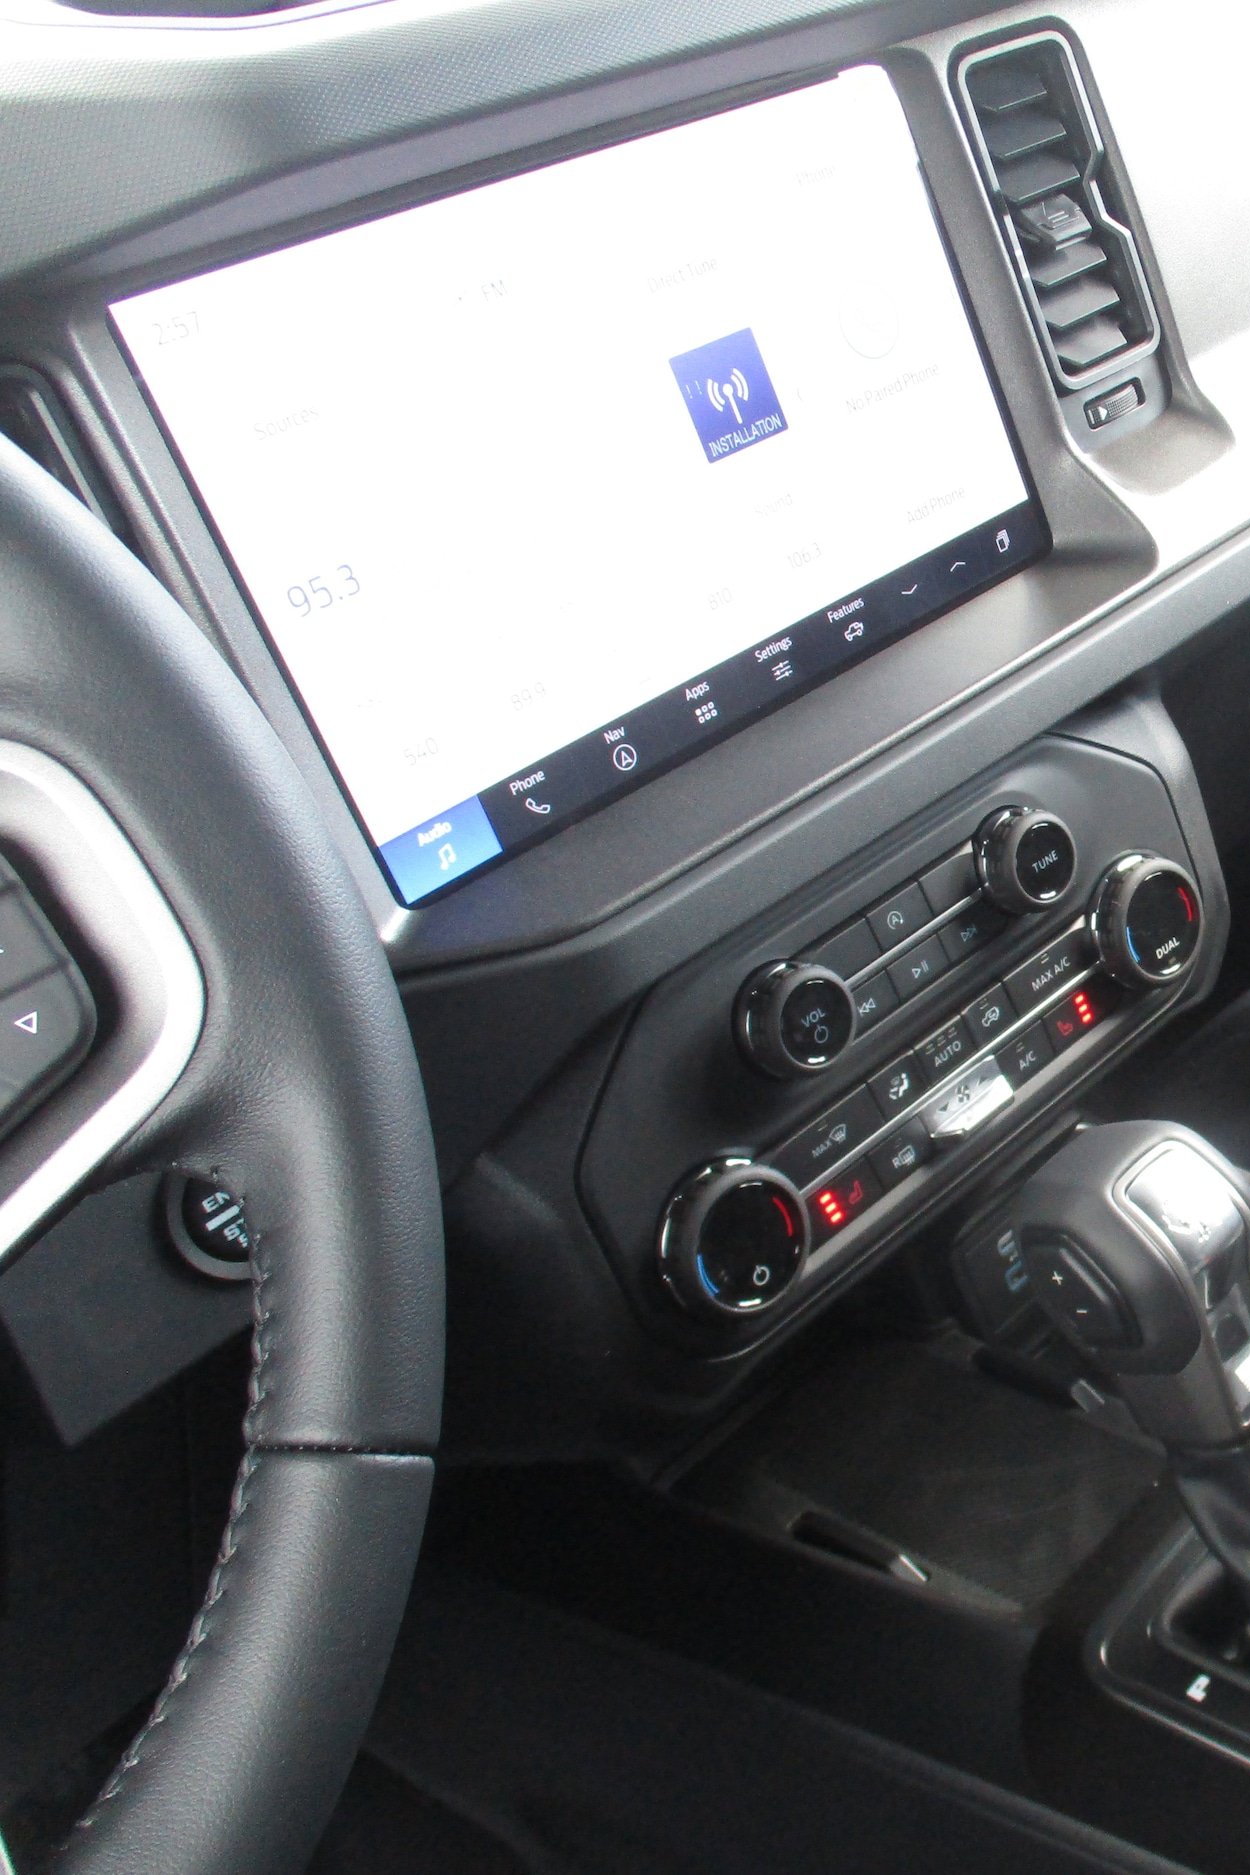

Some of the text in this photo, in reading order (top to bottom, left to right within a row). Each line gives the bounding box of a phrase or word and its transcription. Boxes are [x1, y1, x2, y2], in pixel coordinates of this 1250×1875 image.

[151, 310, 201, 346] 2:57
[252, 404, 321, 441] Sources
[708, 413, 783, 458] INSTALLATION
[286, 563, 361, 618] 95.3
[826, 597, 865, 624] Features
[754, 635, 793, 664] Settings
[684, 680, 711, 702] Apps
[603, 725, 626, 745] Nav
[403, 736, 440, 767] 540
[509, 769, 546, 796] Phone
[416, 821, 453, 847] Audio
[1031, 849, 1059, 874] TUNE
[1155, 936, 1181, 960] DUAL
[1031, 955, 1071, 992] MAX A/C
[801, 1007, 827, 1029] VOL
[933, 1040, 963, 1068] AUTO
[1018, 1050, 1037, 1072] A/C
[811, 1140, 832, 1159] MAX
[1185, 1672, 1212, 1703] P
